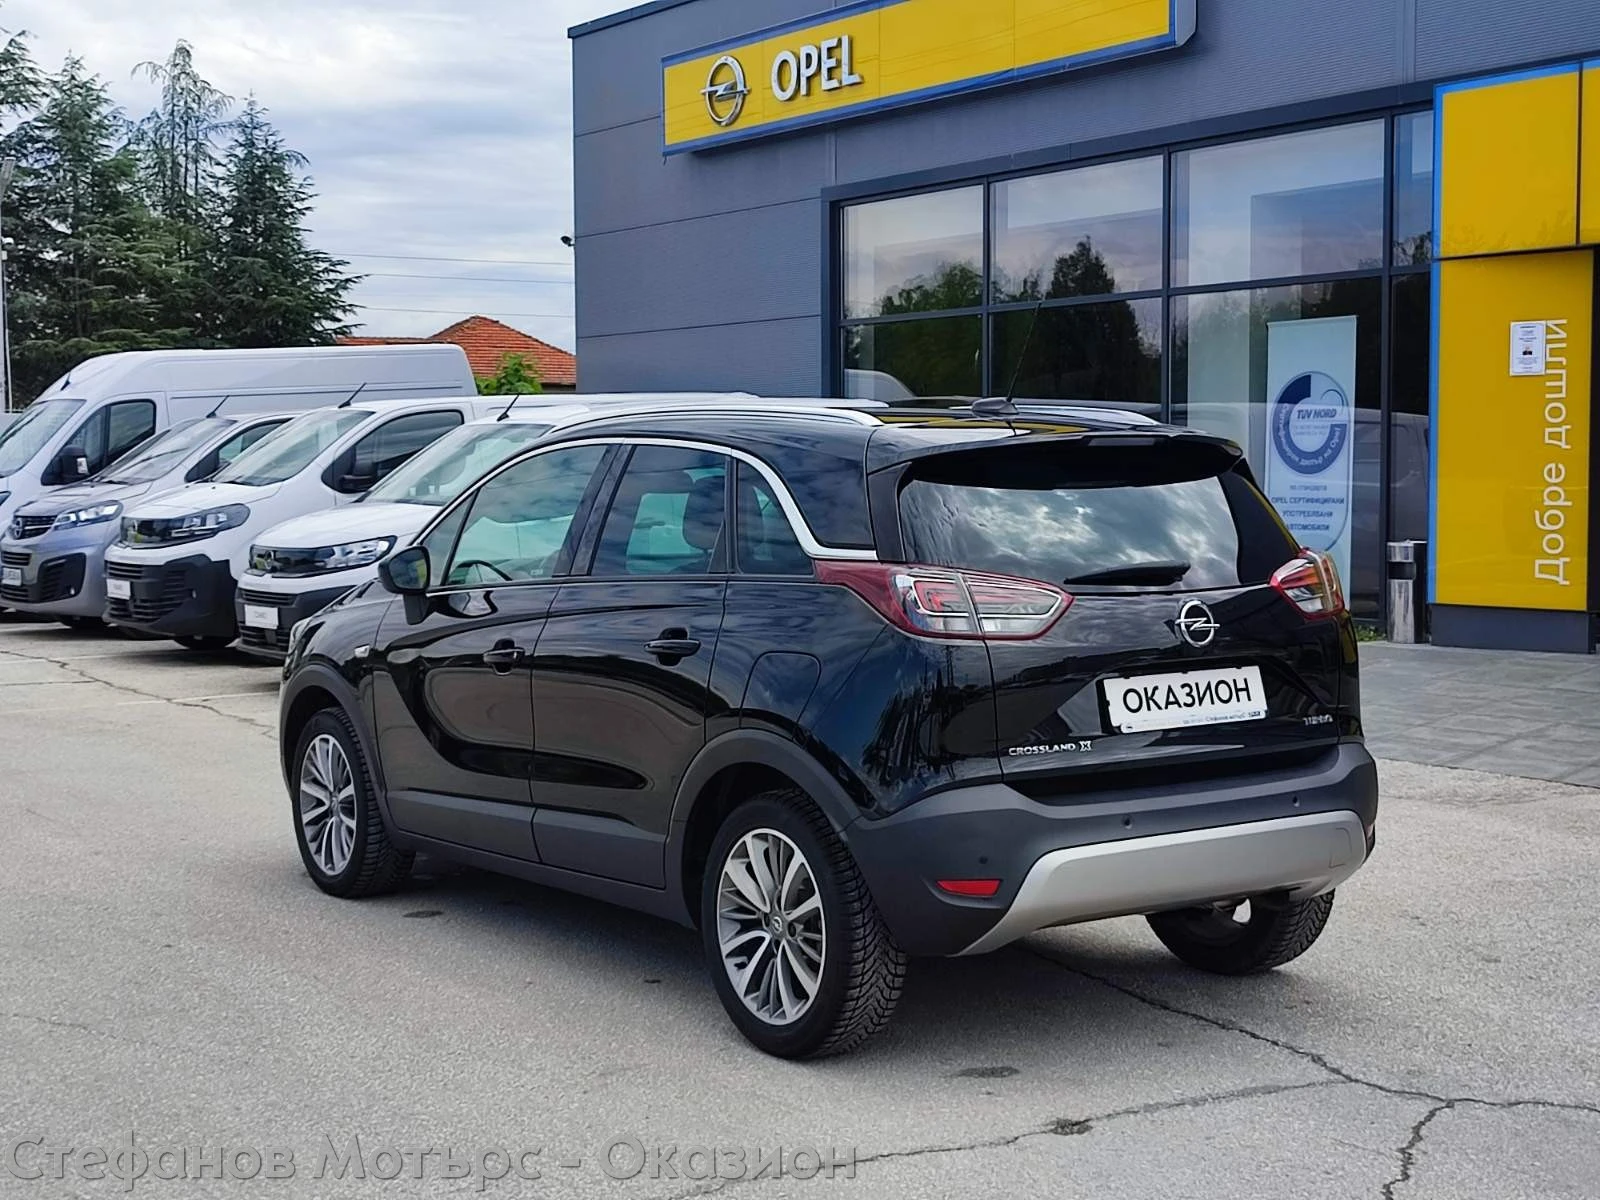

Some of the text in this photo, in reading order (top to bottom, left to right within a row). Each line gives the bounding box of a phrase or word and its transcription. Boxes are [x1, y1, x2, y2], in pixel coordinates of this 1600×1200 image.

[771, 35, 862, 101] OPEL
[1313, 408, 1337, 418] NORD
[1534, 319, 1572, 585] Добре дошли
[1122, 677, 1252, 714] ОКАЗИОН
[1008, 740, 1092, 756] CROSSLAND X
